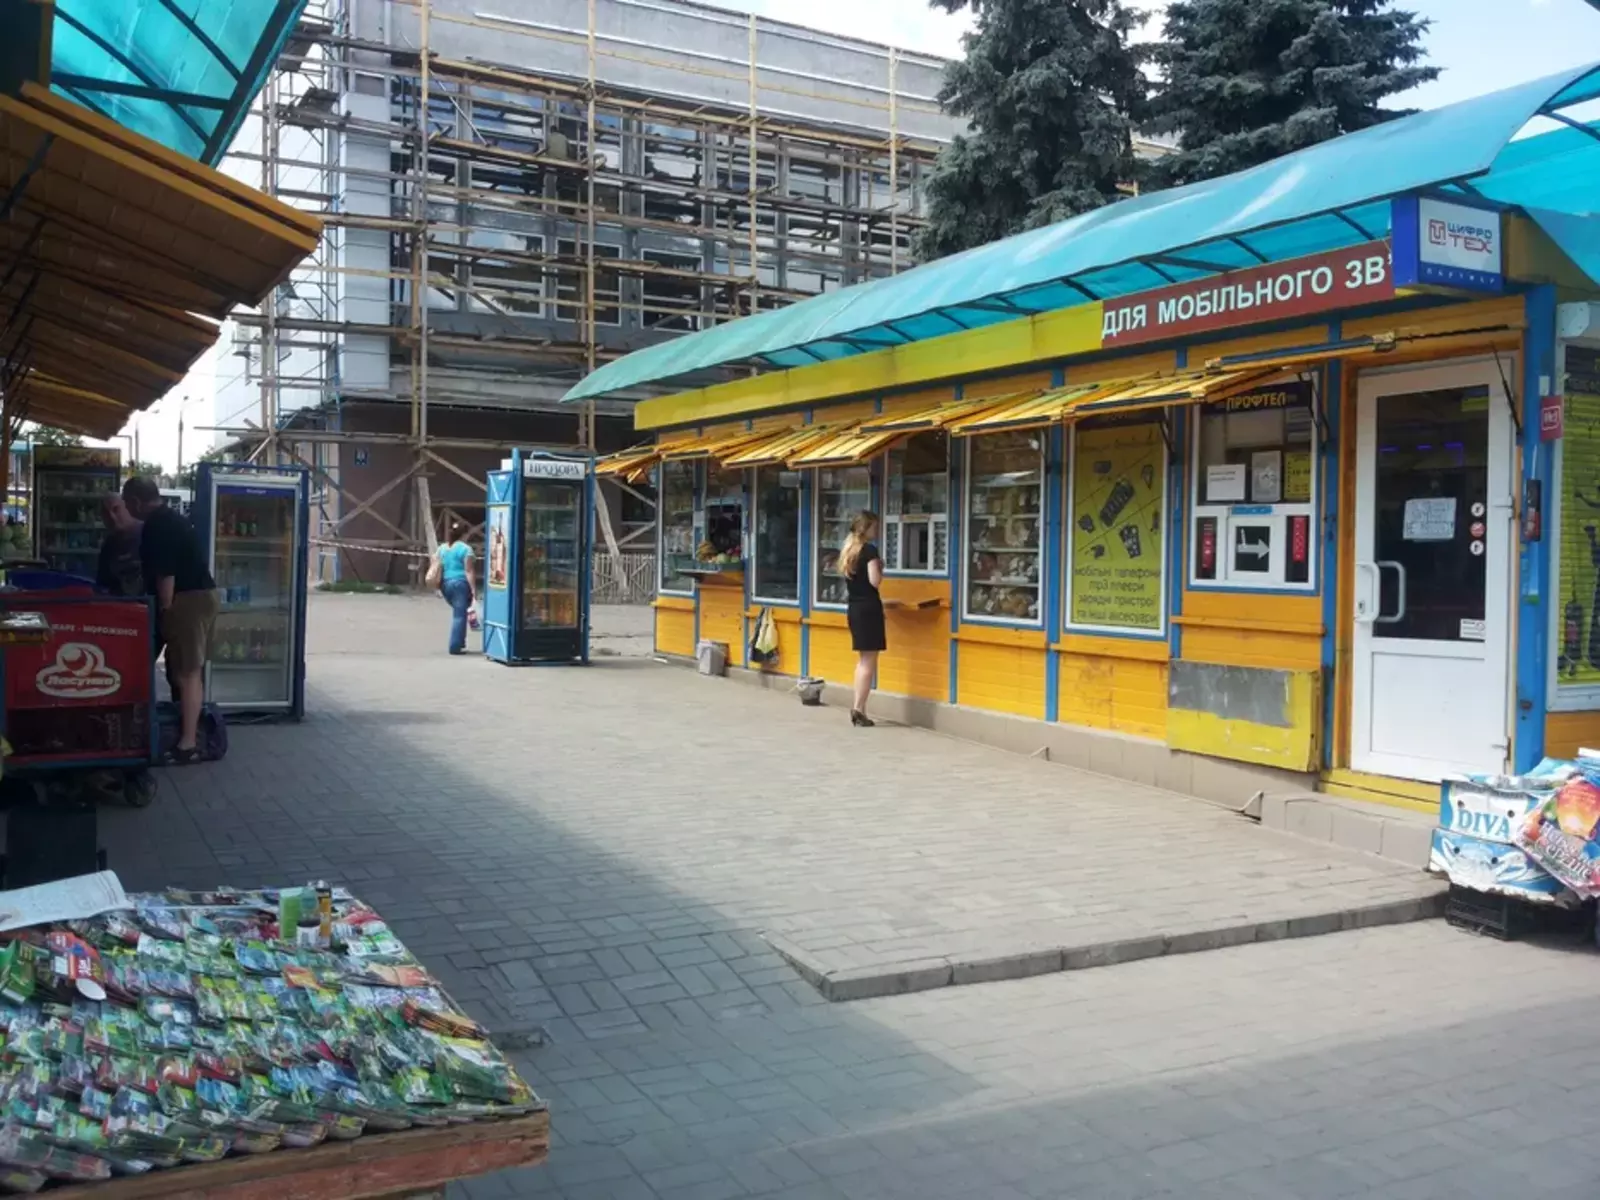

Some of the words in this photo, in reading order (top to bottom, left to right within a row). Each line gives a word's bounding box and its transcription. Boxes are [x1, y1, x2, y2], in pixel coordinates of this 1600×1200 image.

[1447, 222, 1492, 240] ЦИФРО
[1101, 304, 1147, 340] ДЛЯ
[1158, 266, 1333, 325] МОБІЛЬНОГО
[1226, 391, 1287, 412] ПРОФТЕЛ
[1458, 808, 1511, 839] DIVA
